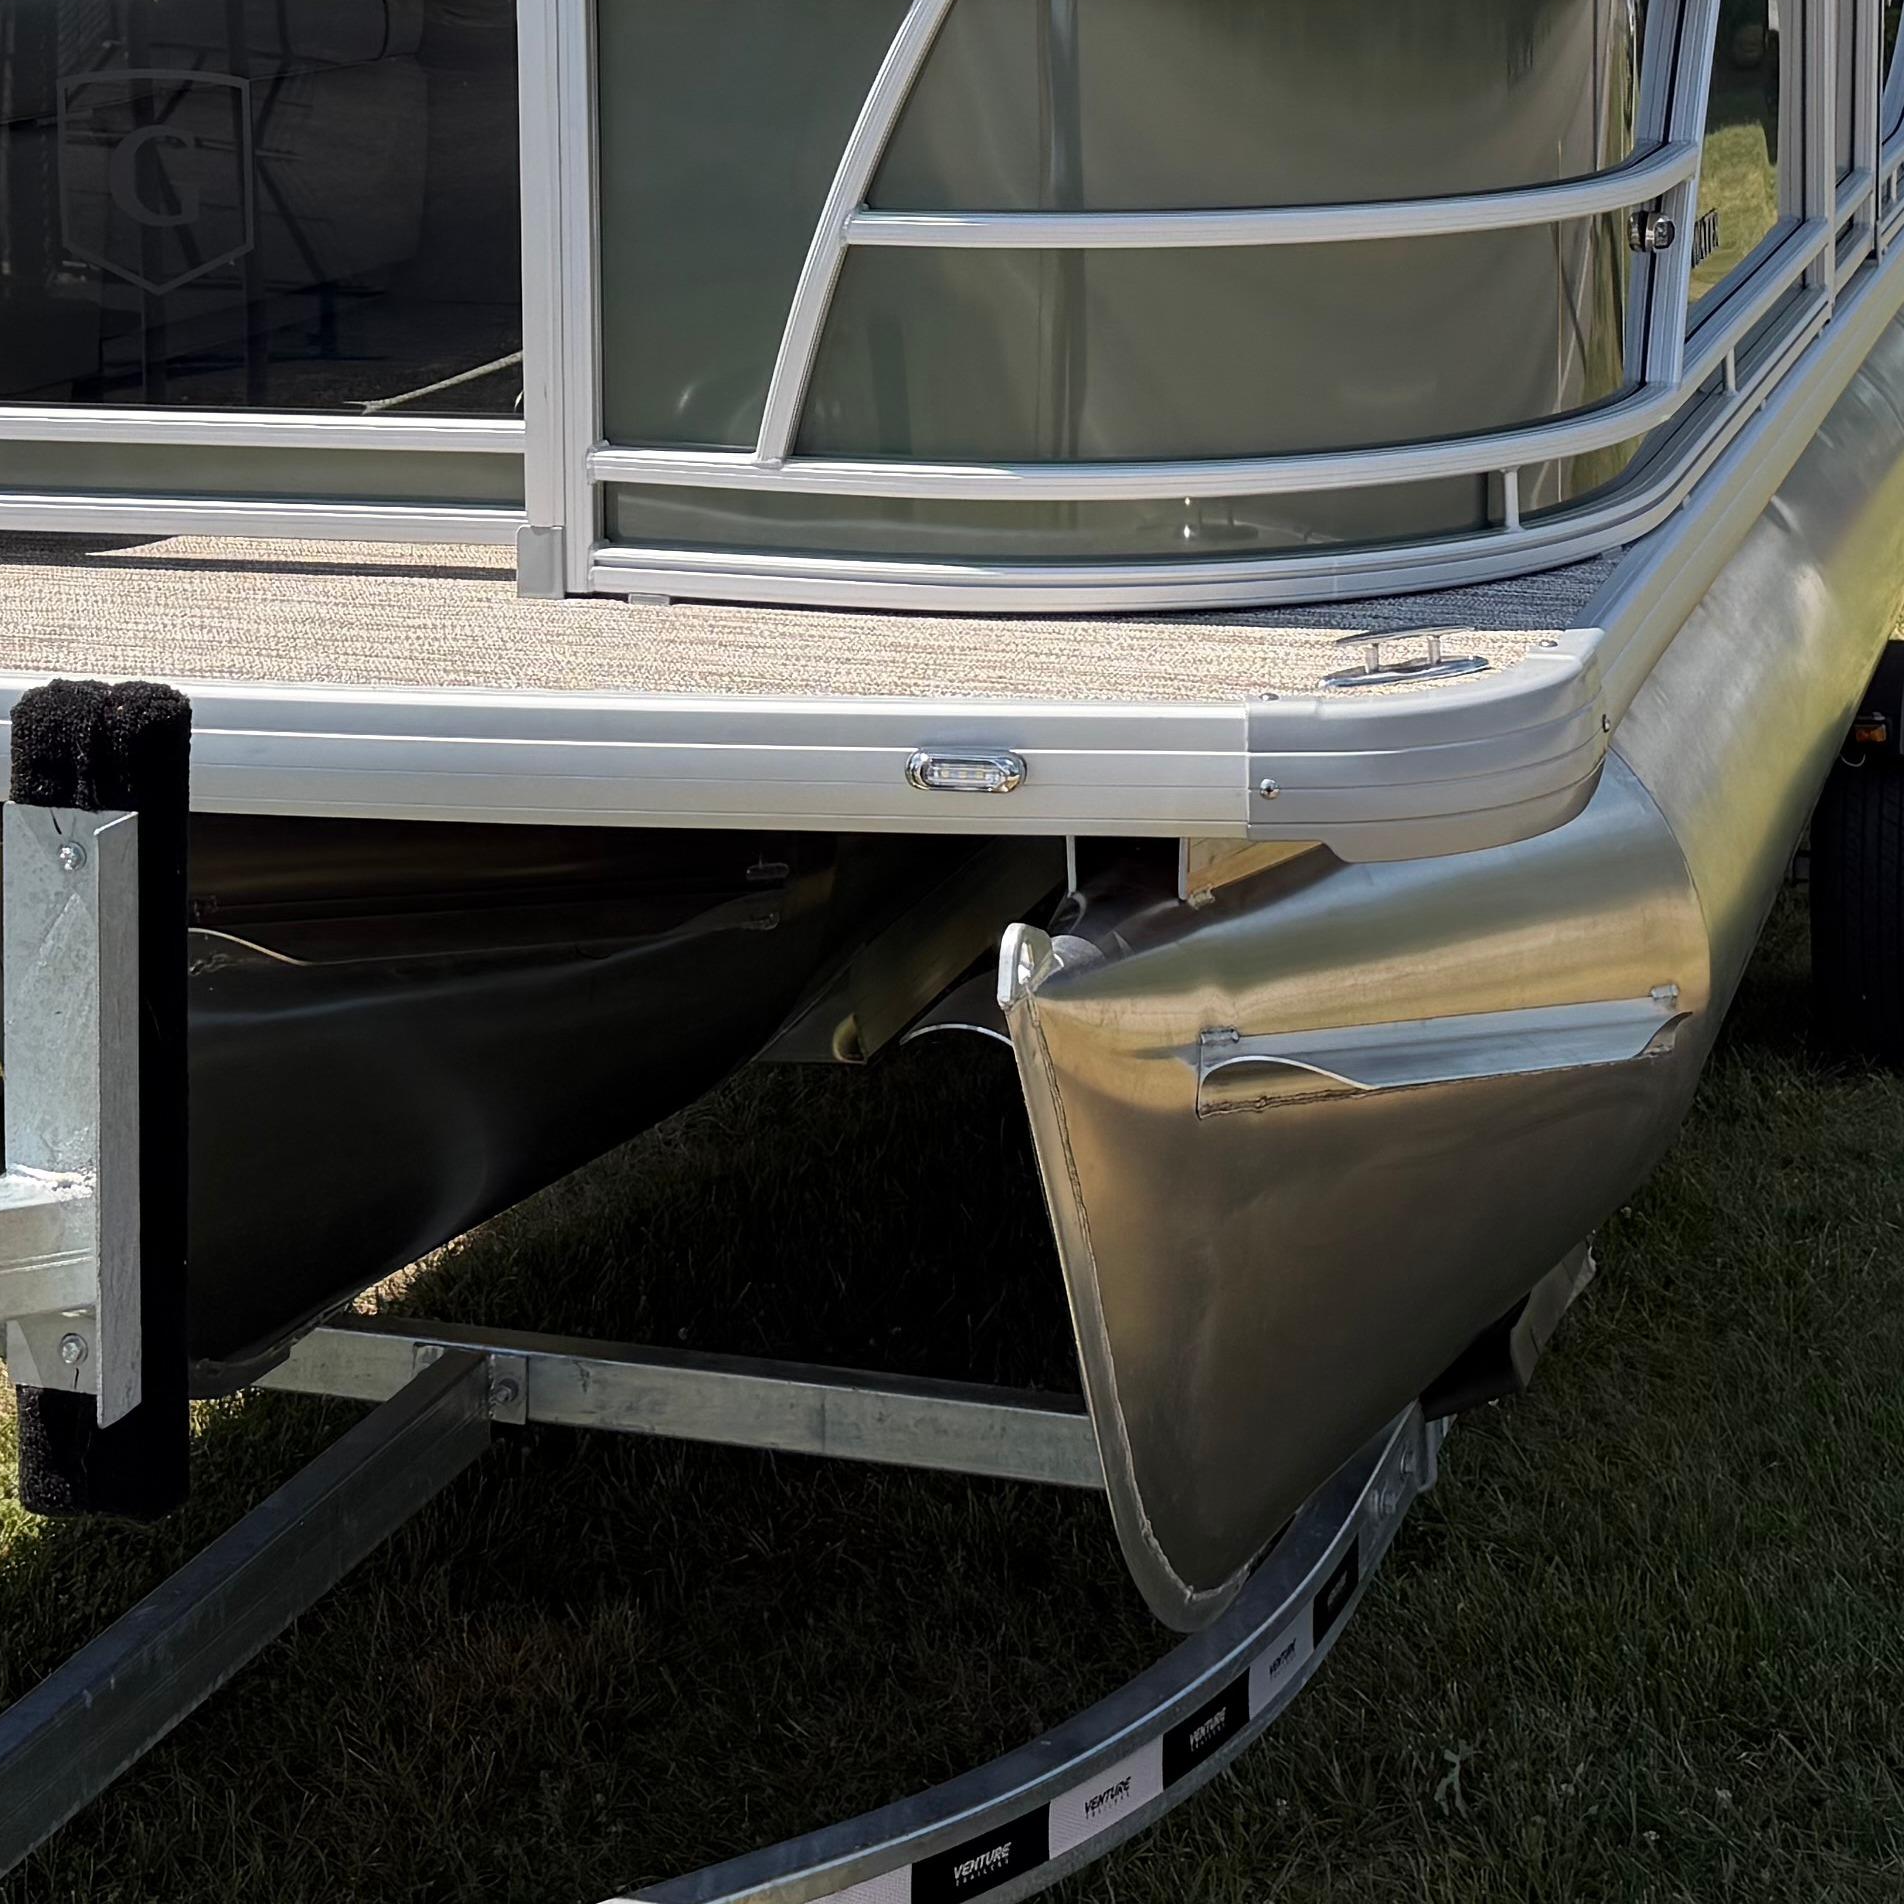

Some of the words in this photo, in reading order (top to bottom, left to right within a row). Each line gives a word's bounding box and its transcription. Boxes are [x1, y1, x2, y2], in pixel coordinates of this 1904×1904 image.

[110, 124, 199, 227] G
[1085, 1776, 1132, 1814] VENTURE
[954, 1841, 1012, 1879] VENTURE
